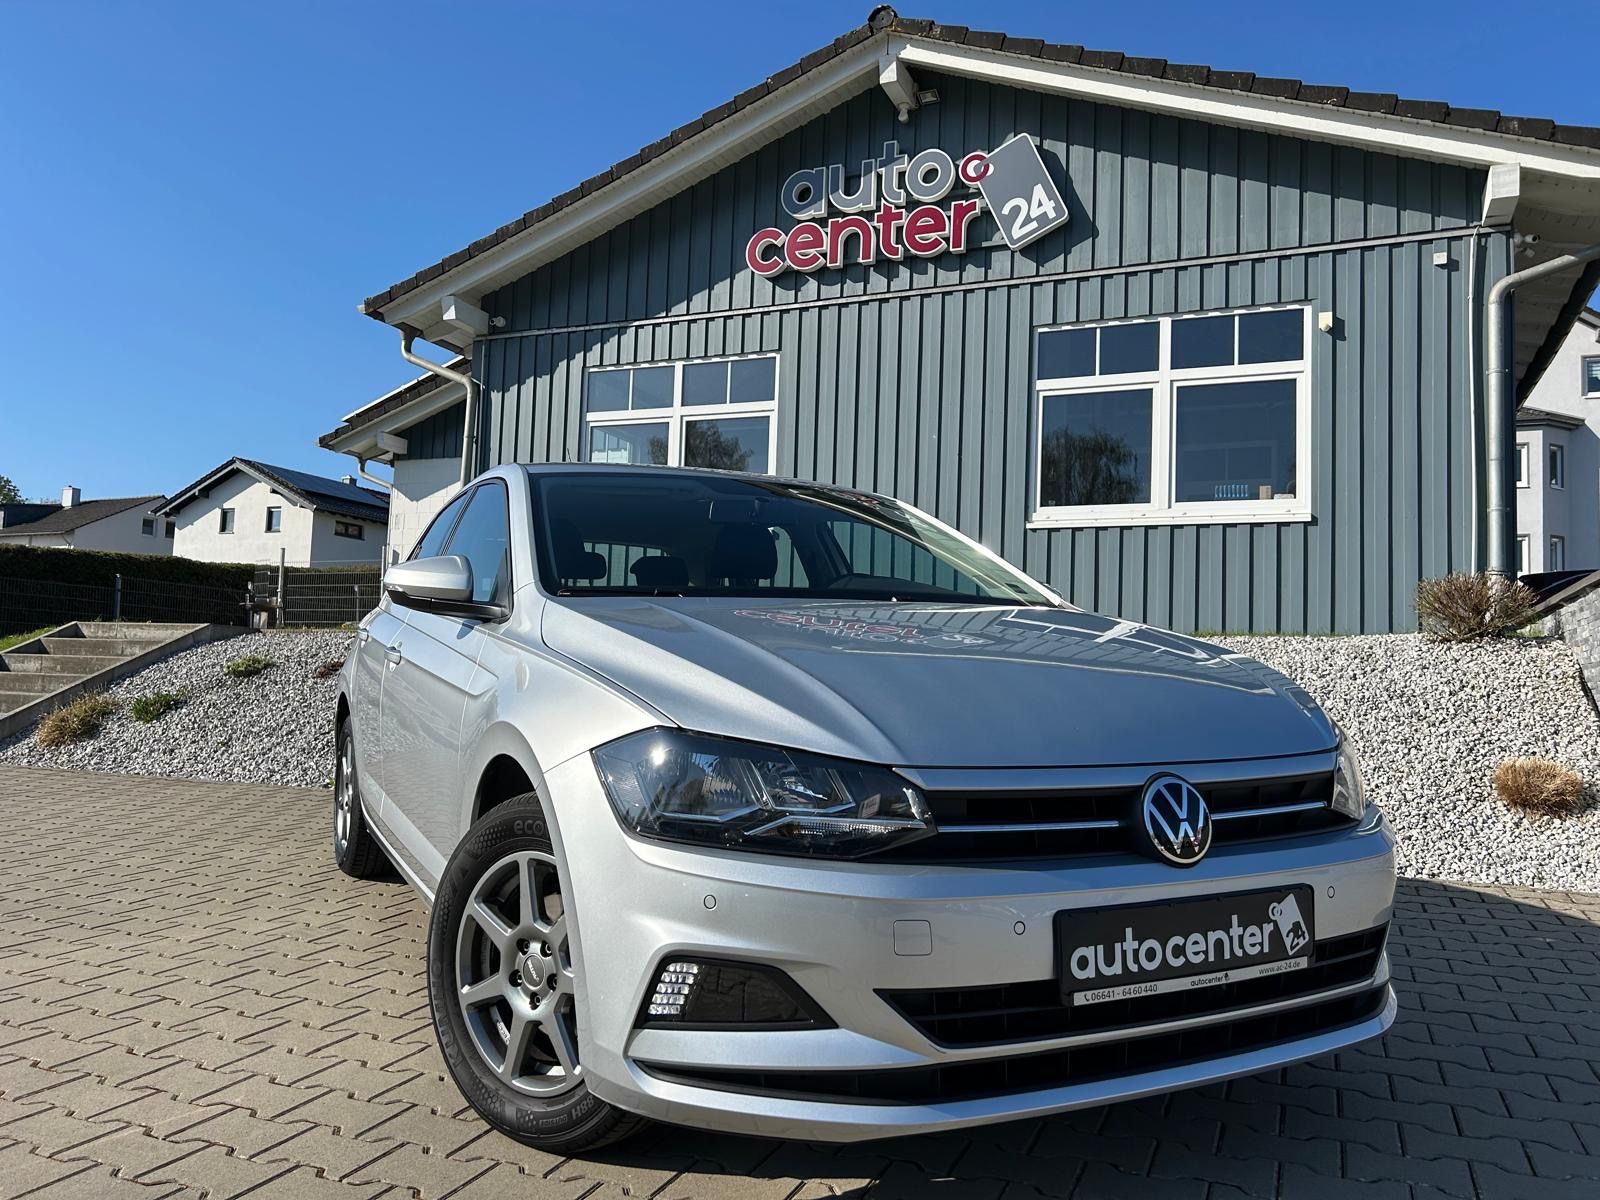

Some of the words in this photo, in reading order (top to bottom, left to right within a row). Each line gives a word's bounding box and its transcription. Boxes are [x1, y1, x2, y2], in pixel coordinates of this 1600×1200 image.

[781, 140, 956, 220] auto
[745, 197, 983, 278] center
[1001, 183, 1057, 240] 24
[1070, 913, 1274, 980] autocenter
[1258, 961, 1301, 975] www.ac-24.de
[1091, 990, 1115, 1002] 06641
[1190, 974, 1224, 987] autocenter
